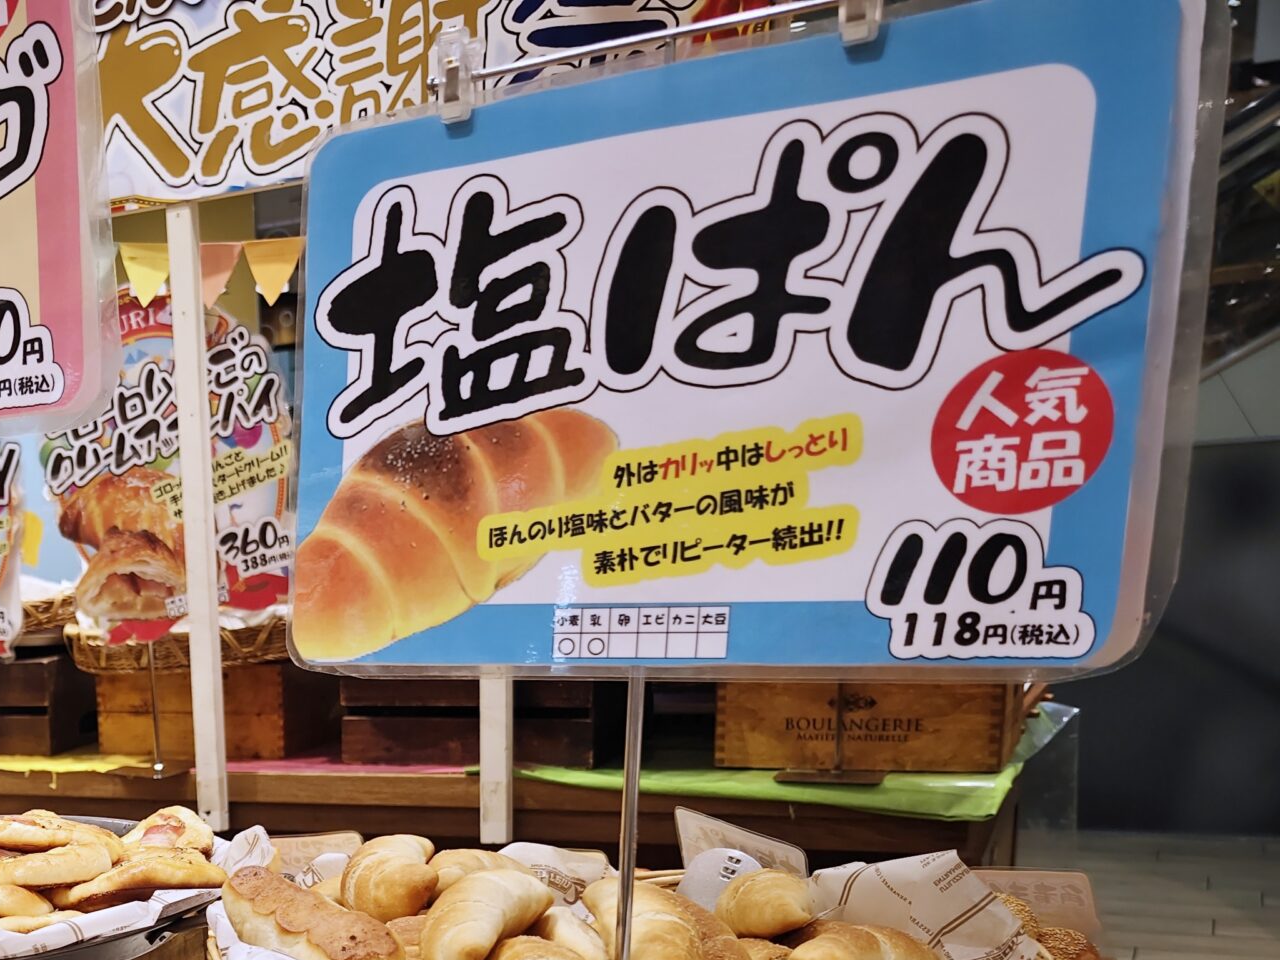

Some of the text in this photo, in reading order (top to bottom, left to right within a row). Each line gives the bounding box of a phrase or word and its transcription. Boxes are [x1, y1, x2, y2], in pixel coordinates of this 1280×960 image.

[328, 131, 1125, 423] 塩ぱん
[955, 366, 1090, 431] 人気
[613, 428, 848, 488] 外はカリッ中はしっとり
[953, 430, 1086, 495] 商品
[219, 521, 289, 560] 360円
[489, 481, 795, 548] ほんのり塩味とバターの風味が
[594, 519, 845, 575] 素朴でリピーター続出!!
[880, 532, 1067, 610] 110円
[589, 613, 602, 626] 乳
[641, 613, 666, 626] エビ
[672, 614, 696, 626] カニ
[903, 611, 1080, 647] 118円(税込)
[784, 717, 924, 733] BOULANGERIE
